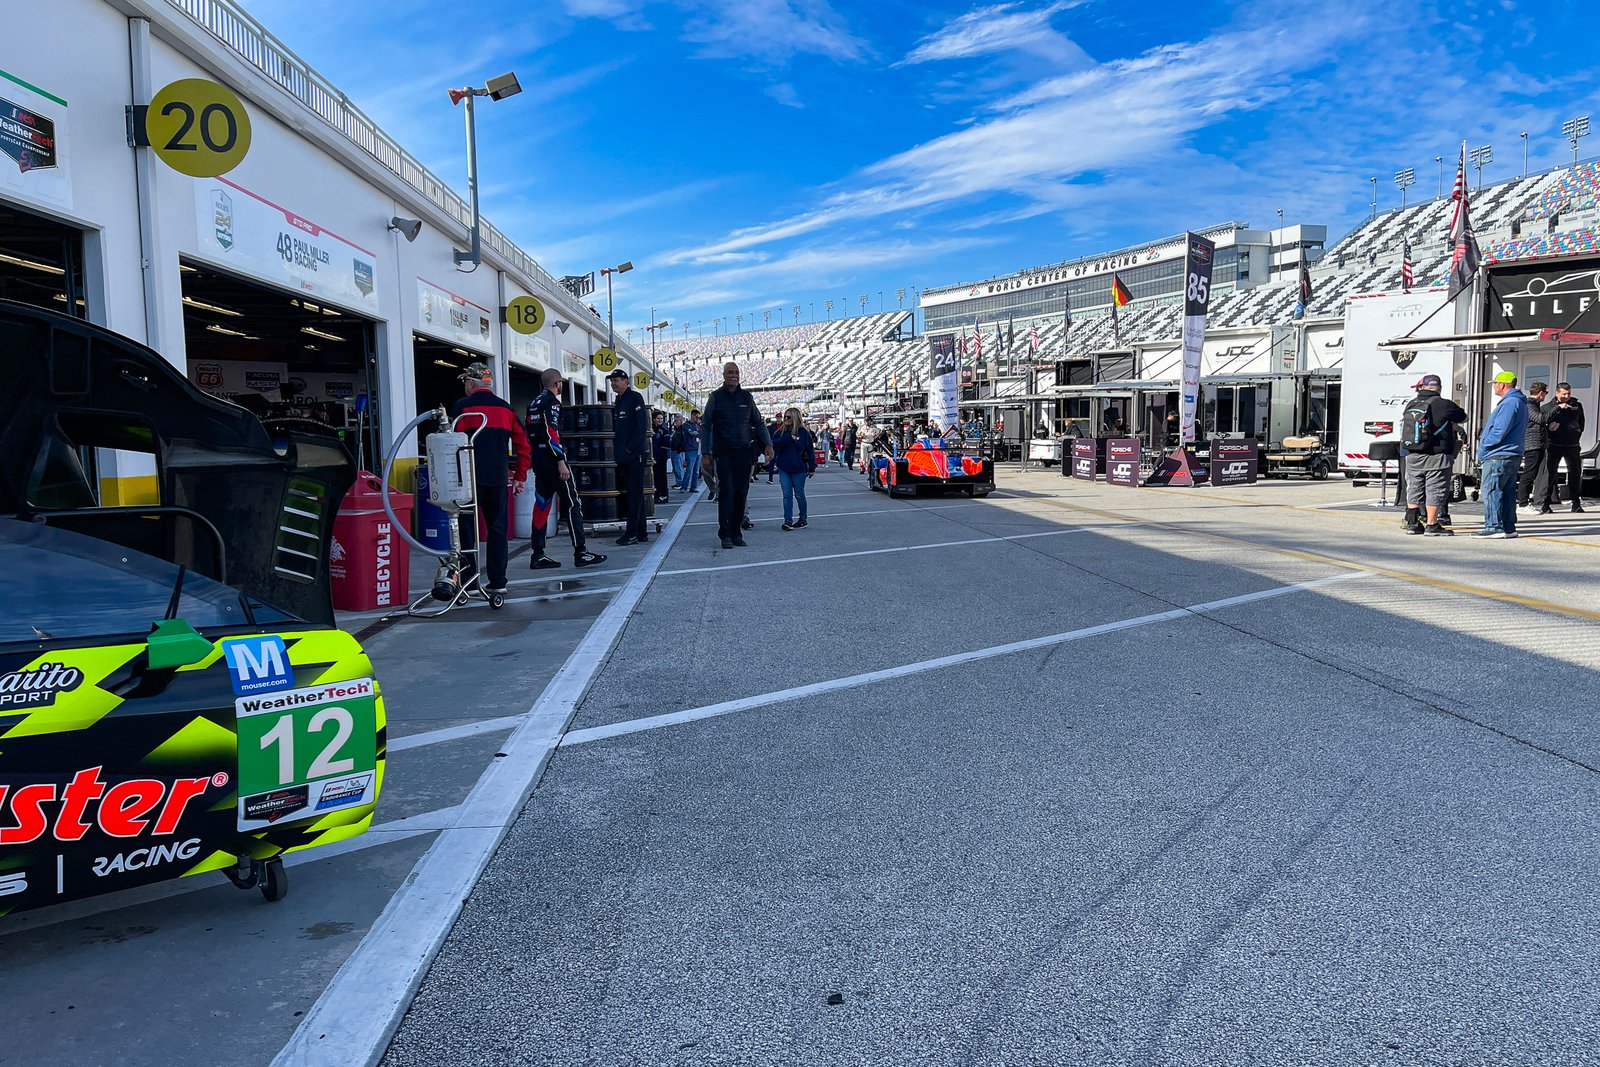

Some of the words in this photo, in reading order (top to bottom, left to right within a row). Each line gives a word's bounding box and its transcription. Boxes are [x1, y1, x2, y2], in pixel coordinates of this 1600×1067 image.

[0, 118, 53, 148] eatherTech
[161, 101, 237, 153] 20
[276, 231, 293, 263] 48
[293, 237, 310, 256] PAUL
[310, 245, 330, 265] MILLER
[294, 252, 318, 272] RACING
[988, 280, 1021, 293] WORLD
[1027, 270, 1067, 286] CENTER
[1074, 265, 1087, 277] OF
[1094, 255, 1138, 272] RACING
[1187, 272, 1208, 304] 85
[514, 305, 538, 325] 18
[1502, 292, 1600, 317] RILE
[599, 353, 613, 366] 16
[935, 352, 955, 369] 24
[200, 374, 218, 384] 66
[636, 376, 647, 385] 14
[665, 392, 672, 400] 12
[376, 522, 391, 606] RECYCLE
[230, 640, 286, 681] M
[0, 663, 78, 692] arito
[241, 678, 288, 691] mouser.com
[0, 691, 53, 705] PORT
[243, 682, 370, 713] WeatherTech
[260, 707, 354, 785] 12
[92, 838, 201, 877] RACING
